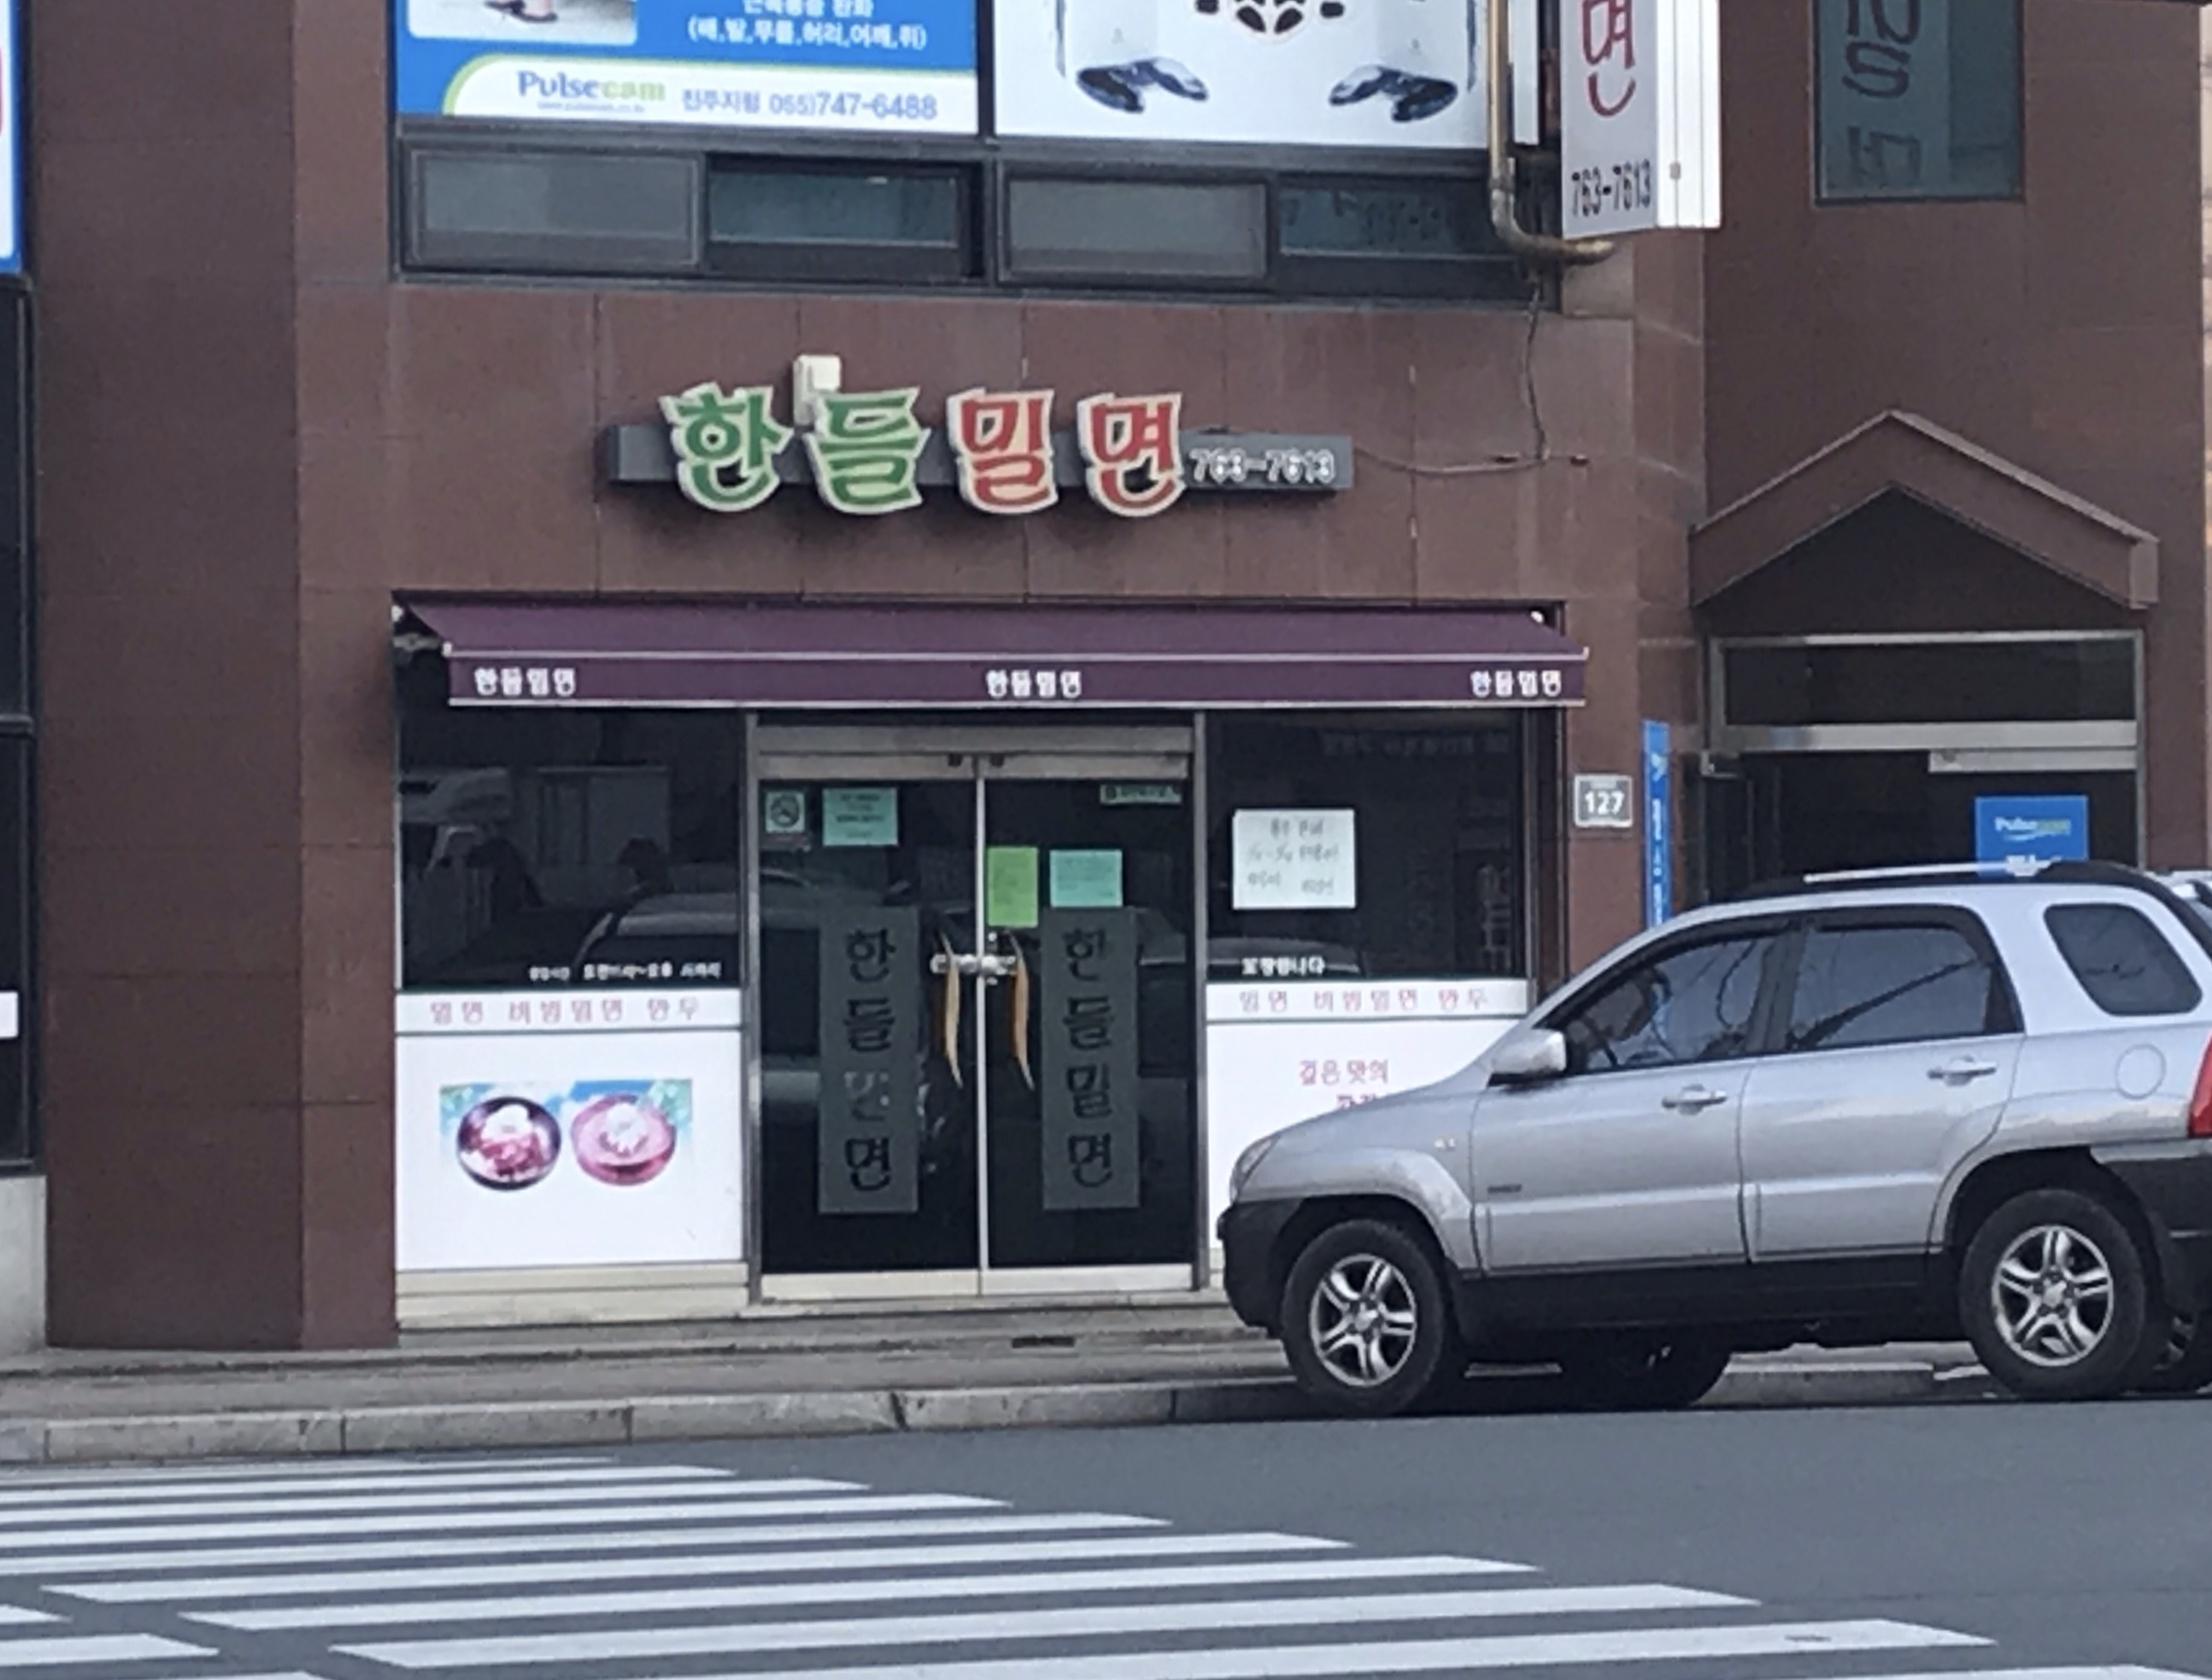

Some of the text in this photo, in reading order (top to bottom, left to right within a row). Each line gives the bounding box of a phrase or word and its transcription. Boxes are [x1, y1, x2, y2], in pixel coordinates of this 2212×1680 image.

[1582, 0, 1637, 117] 면
[517, 70, 666, 102] Pulsecam
[1571, 158, 1650, 217] 763-7613
[660, 380, 1335, 518] 한들밀면 763-7613
[474, 667, 577, 697] 한들밀면
[985, 668, 1082, 699] 한들밀면
[1470, 669, 1562, 699] 한들밀면
[1585, 790, 1625, 815] 127
[1063, 928, 1114, 1188] 한들밀면
